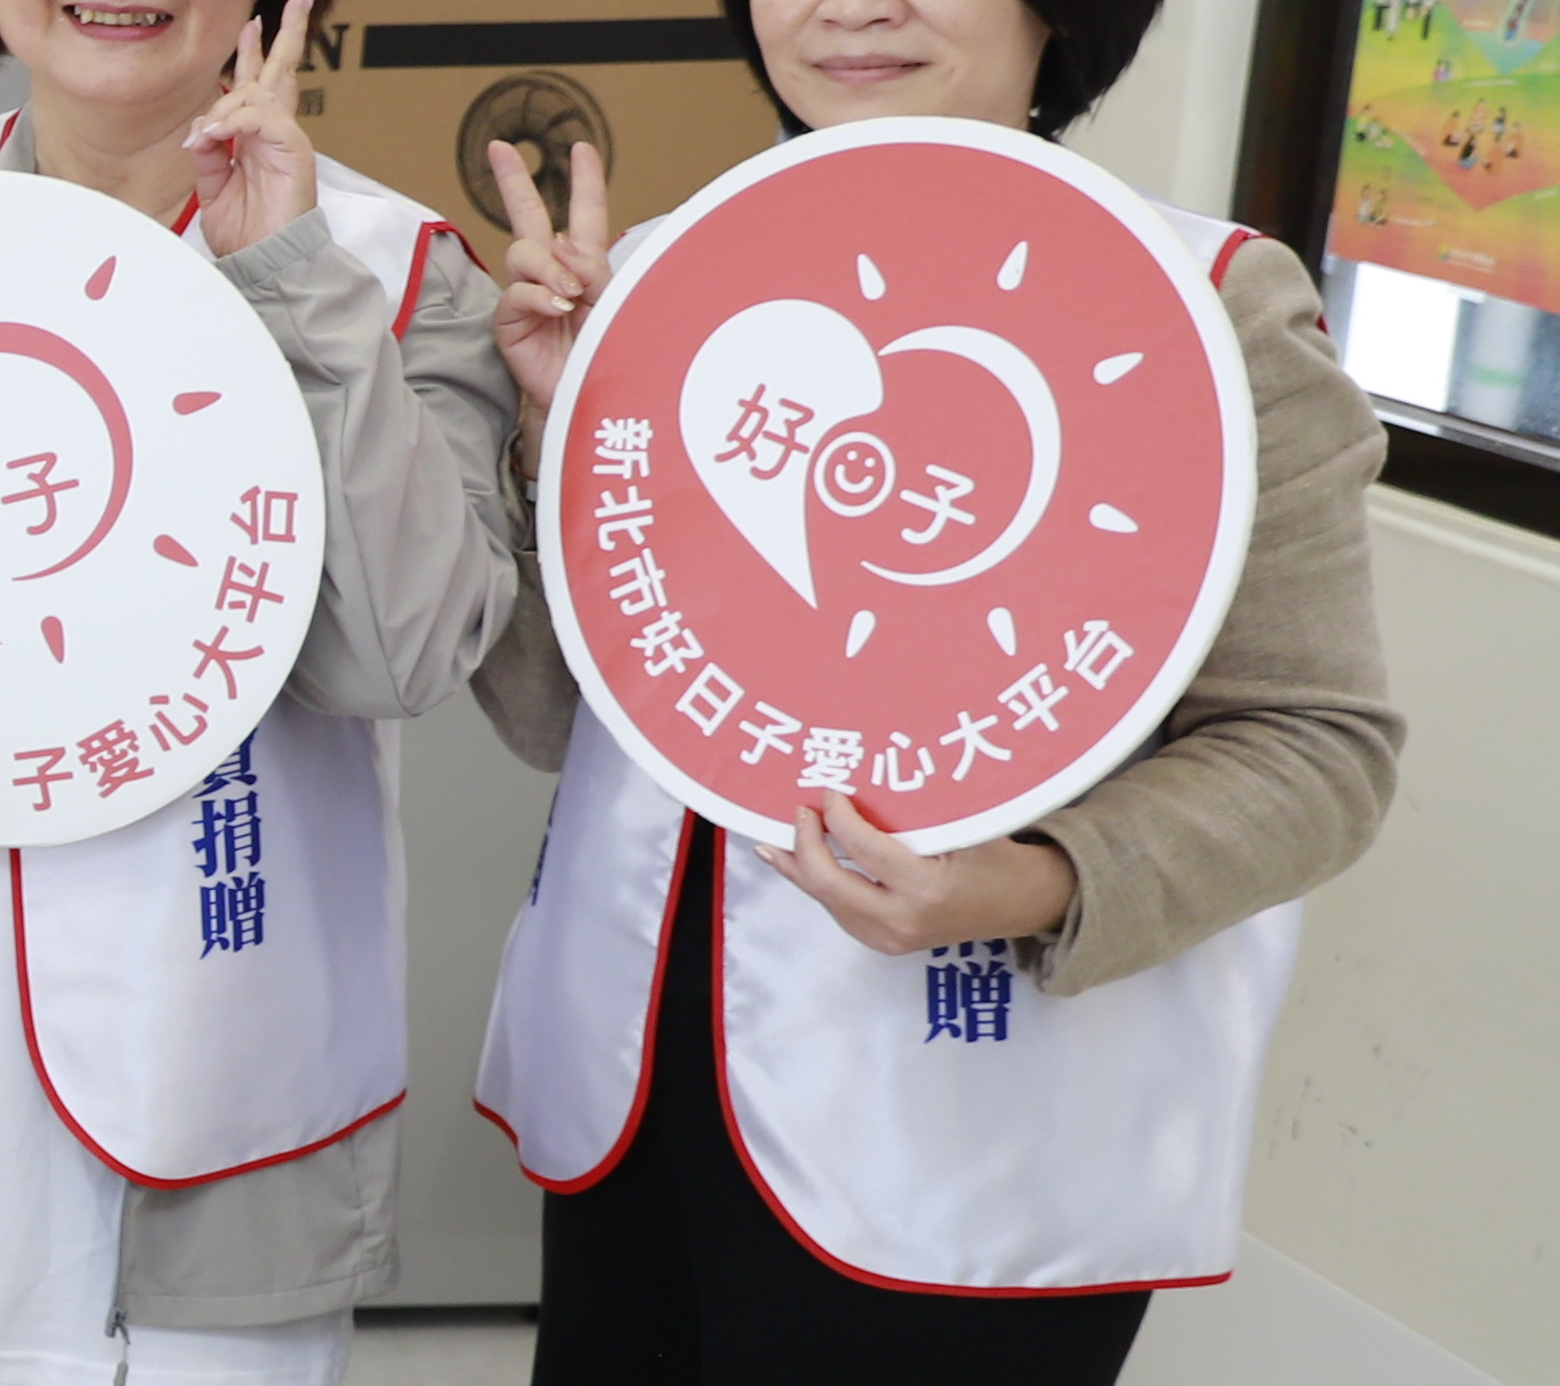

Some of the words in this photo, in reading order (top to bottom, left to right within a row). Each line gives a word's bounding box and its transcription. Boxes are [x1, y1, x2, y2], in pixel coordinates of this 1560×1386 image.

[592, 417, 1135, 794] 新北市好日子愛心大平台
[924, 938, 1014, 1044] 贈
